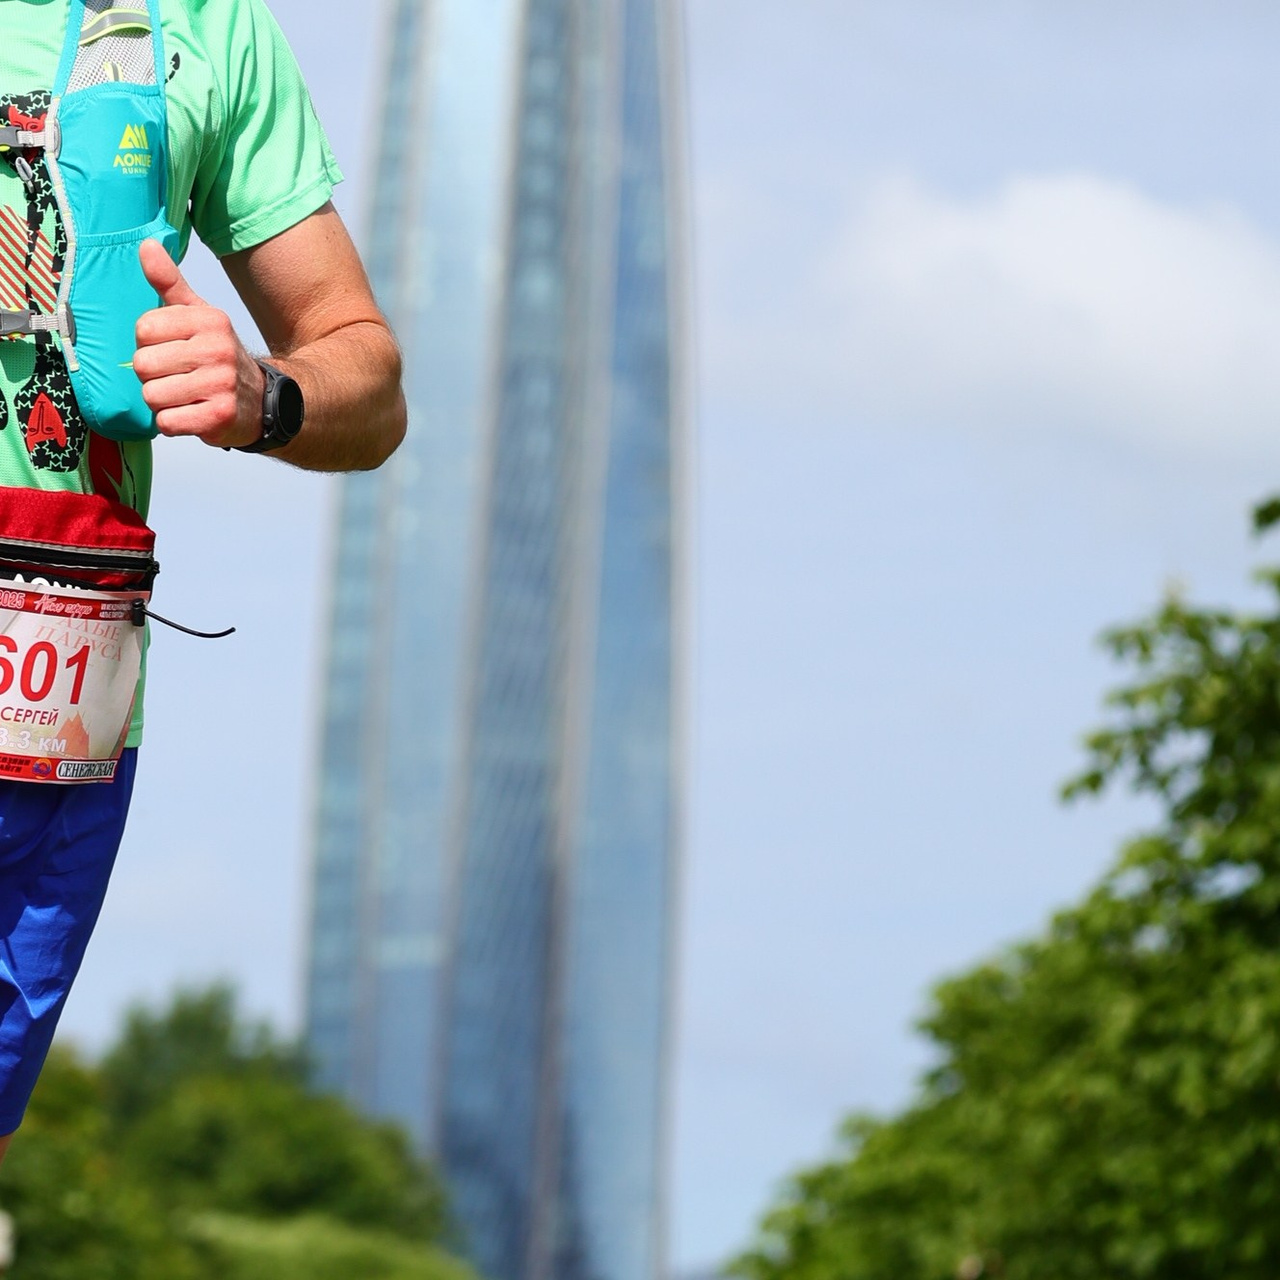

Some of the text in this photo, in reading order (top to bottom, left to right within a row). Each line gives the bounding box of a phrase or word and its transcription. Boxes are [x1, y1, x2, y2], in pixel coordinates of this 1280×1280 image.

[57, 617, 122, 641] АЛЫЕ
[35, 625, 122, 662] ПАРУСА
[0, 706, 59, 726] СЕРГЕЙ
[58, 761, 116, 778] СЕНЕЖСКАЯ
